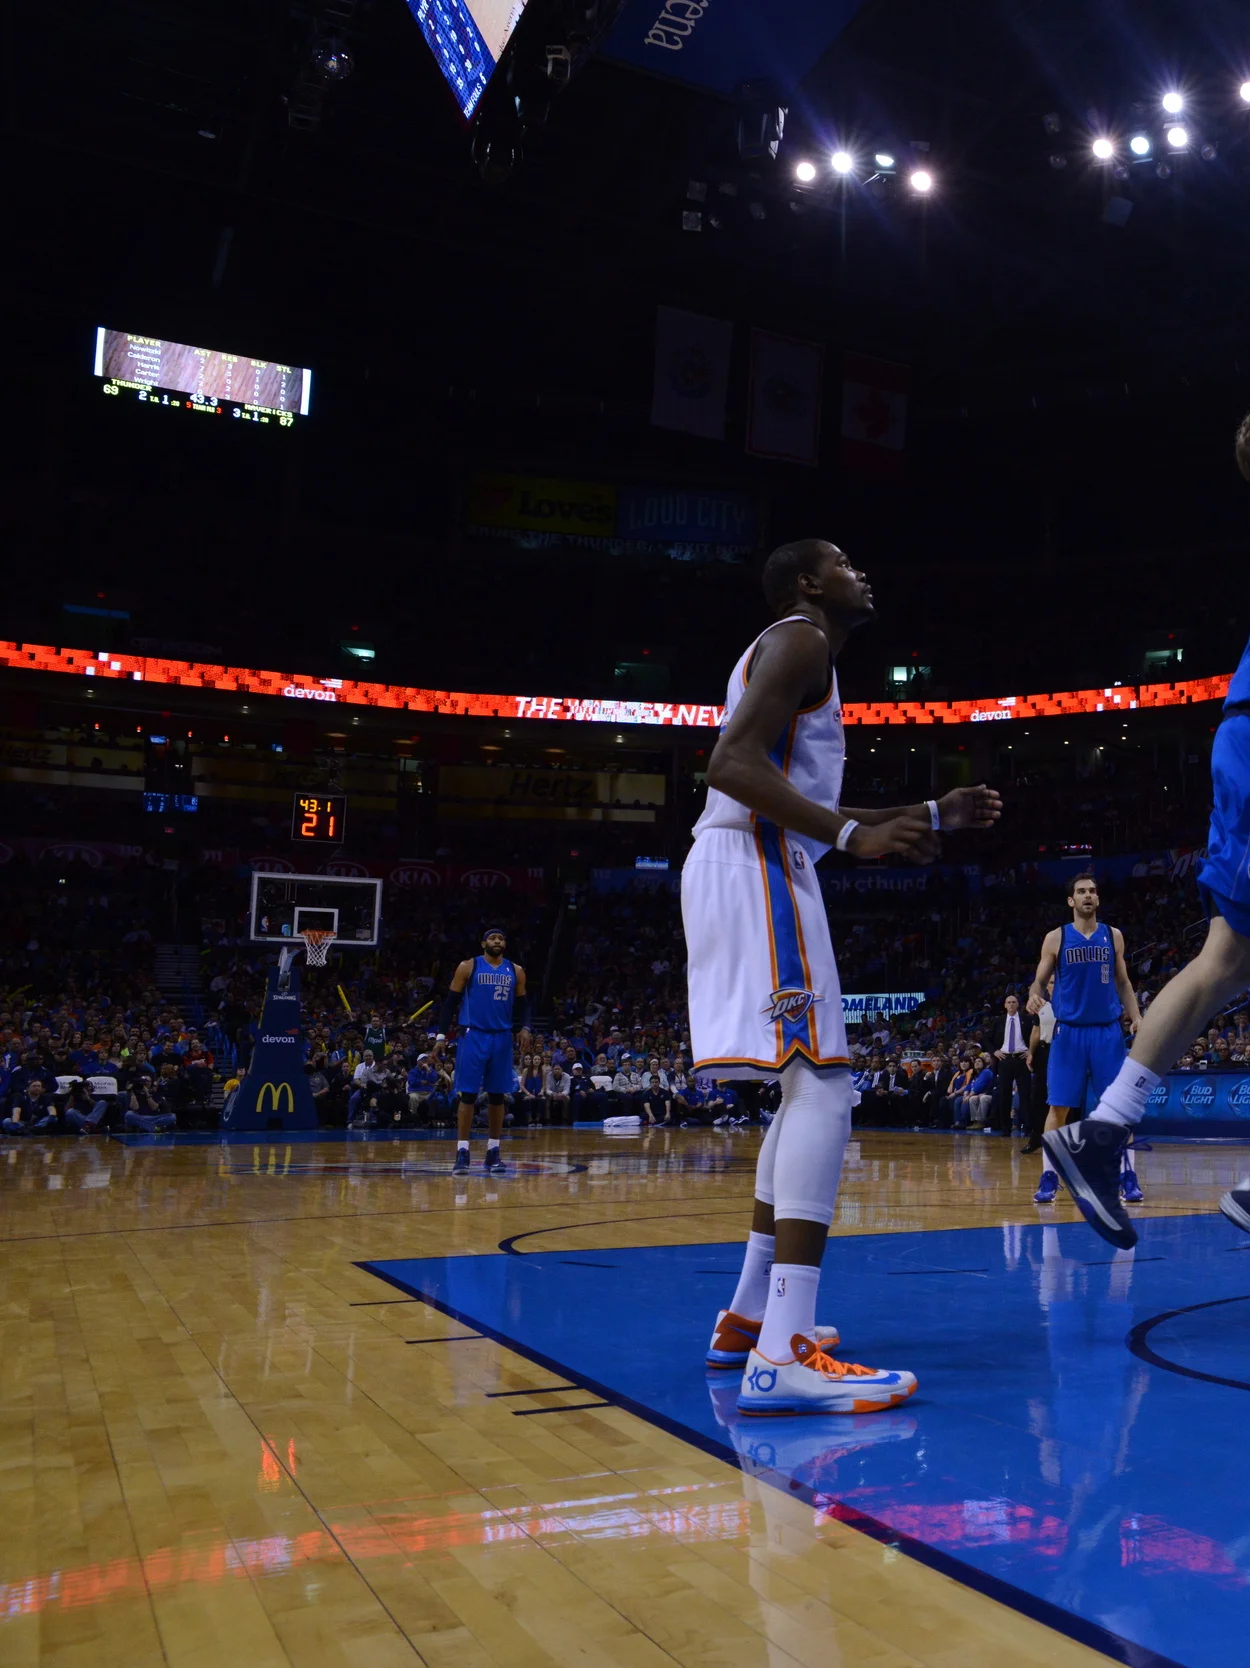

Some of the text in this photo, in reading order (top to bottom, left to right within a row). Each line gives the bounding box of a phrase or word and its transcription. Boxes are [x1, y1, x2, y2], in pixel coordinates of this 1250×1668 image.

[127, 335, 292, 374] PLAYER AST REB BLK STL
[127, 352, 161, 362] Calderon
[135, 368, 160, 378] Carter
[137, 361, 160, 371] Harris
[111, 378, 153, 392] THUNDER
[133, 376, 159, 387] Wright
[103, 384, 119, 396] 69
[138, 390, 147, 401] 2
[162, 394, 169, 405] 1
[190, 393, 219, 407] 43.3
[232, 408, 240, 418] 3
[252, 411, 259, 421] 1
[244, 404, 293, 418] MAVERICKS
[279, 416, 294, 428] 87
[628, 496, 688, 531] LOUD
[697, 496, 747, 535] CITY
[283, 684, 337, 702] devon
[515, 696, 563, 719] THE
[970, 709, 1012, 722] devon
[509, 771, 595, 799] Hertz
[300, 798, 332, 812] 43.1
[301, 813, 336, 838] 21
[398, 869, 434, 887] KIA
[1065, 945, 1111, 965] DALLAS
[477, 974, 512, 987] DALLAS
[1100, 963, 1111, 984] 8
[493, 986, 510, 1001] 25
[772, 993, 806, 1016] OKC
[262, 1033, 295, 1044] devon
[1190, 1084, 1213, 1095] BUD
[1183, 1094, 1215, 1105] LIGHT
